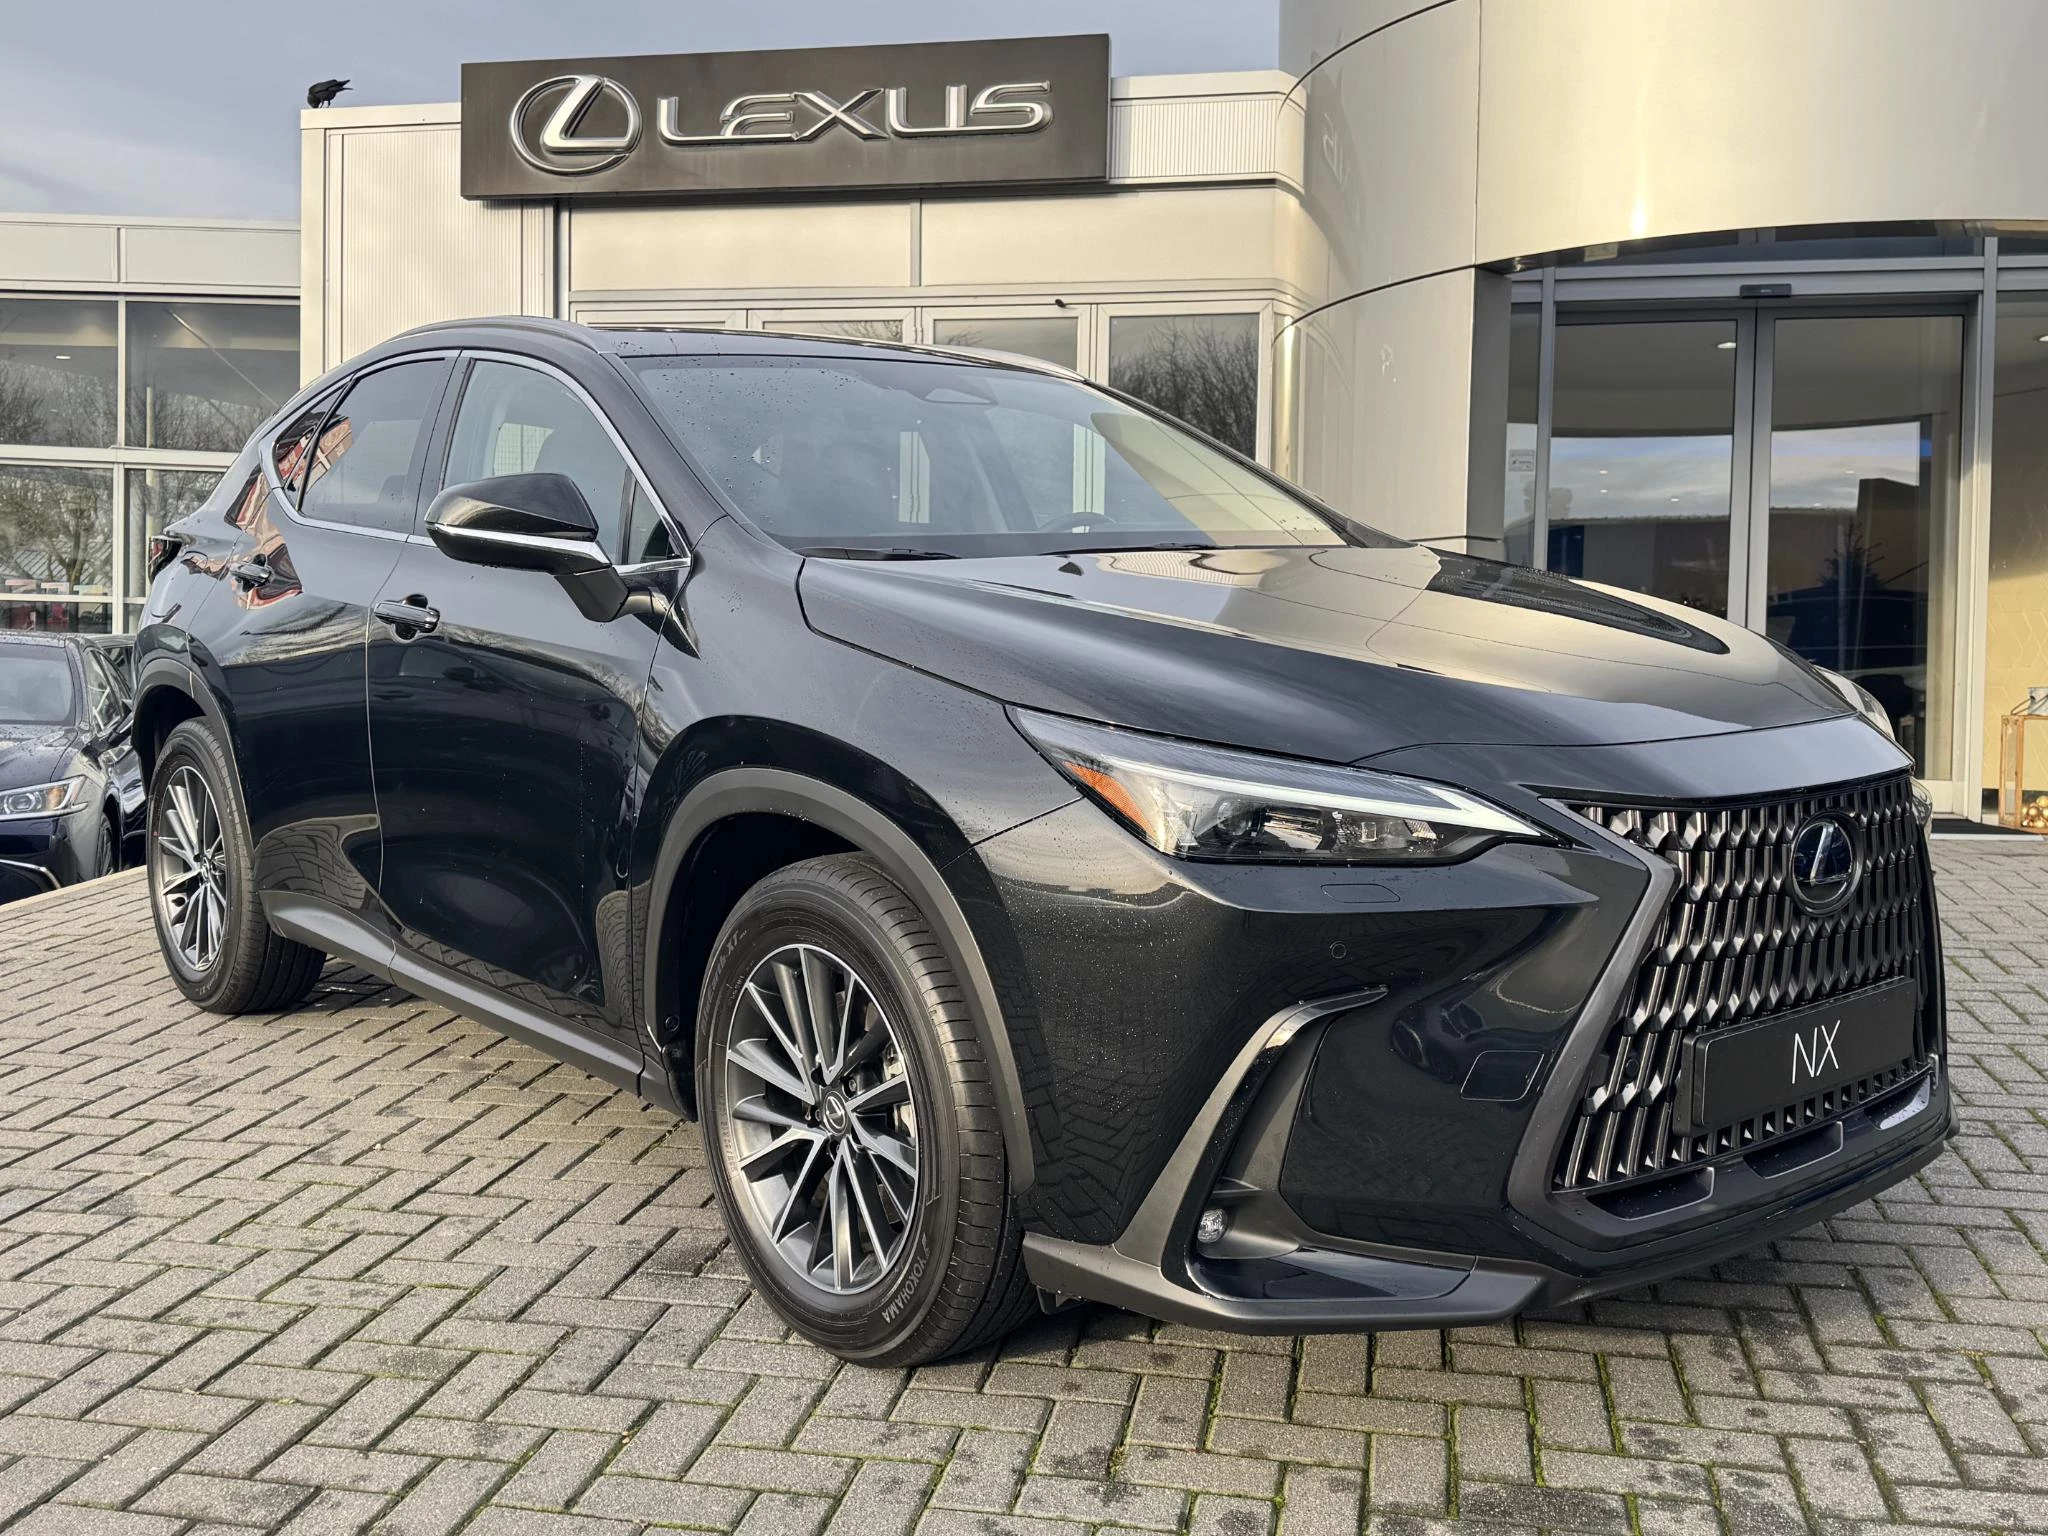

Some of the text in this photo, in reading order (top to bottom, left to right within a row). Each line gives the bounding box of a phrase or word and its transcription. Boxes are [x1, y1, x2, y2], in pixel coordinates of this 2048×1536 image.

[656, 80, 1053, 147] LEXUS
[1791, 1019, 1841, 1085] NX
[881, 1255, 927, 1324] YOKOHAMA
